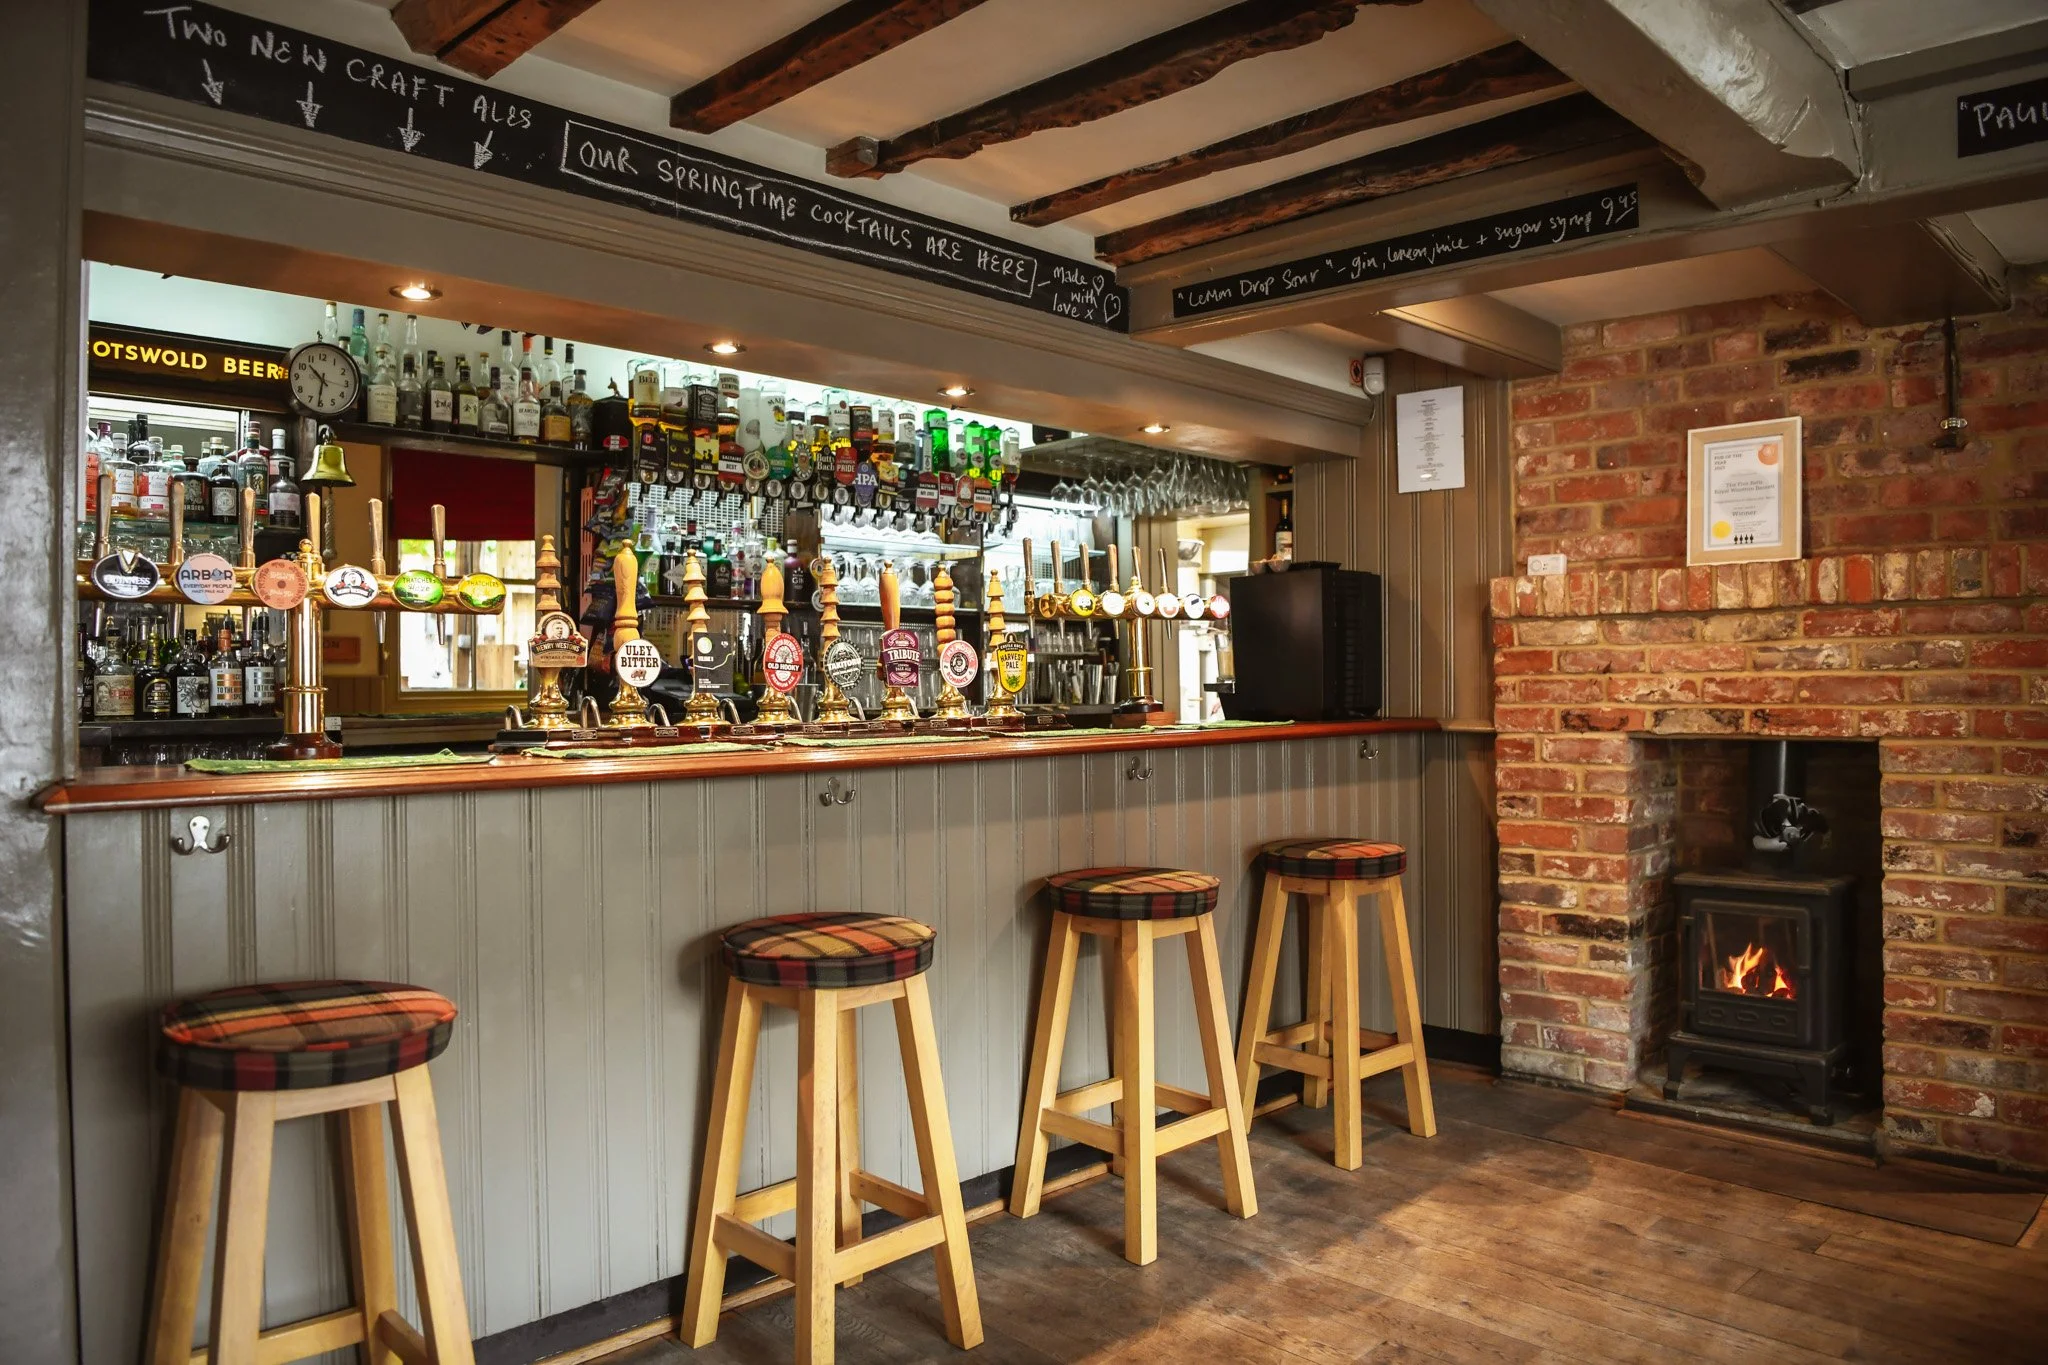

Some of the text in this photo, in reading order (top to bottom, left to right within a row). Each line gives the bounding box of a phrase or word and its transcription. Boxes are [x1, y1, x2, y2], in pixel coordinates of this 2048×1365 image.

[250, 31, 328, 74] NEW
[346, 58, 455, 108] CRAFT
[473, 95, 532, 129] ALES
[580, 141, 1028, 283] OUR SPRINGTIME COCKTAILS ARE HERE
[1240, 276, 1274, 297] Drop
[1494, 220, 1541, 249] sugar
[1053, 266, 1088, 285] Made
[1053, 293, 1080, 318] love
[1071, 289, 1098, 308] with
[86, 341, 207, 370] OTSWOLD
[837, 464, 855, 472] PRIDE
[625, 645, 653, 656] ULEY
[888, 649, 920, 661] TRIBUTE
[1000, 653, 1024, 662] HARVEST
[620, 656, 659, 668] BITTER
[780, 663, 800, 671] HOOKY
[1005, 661, 1019, 669] PALE
